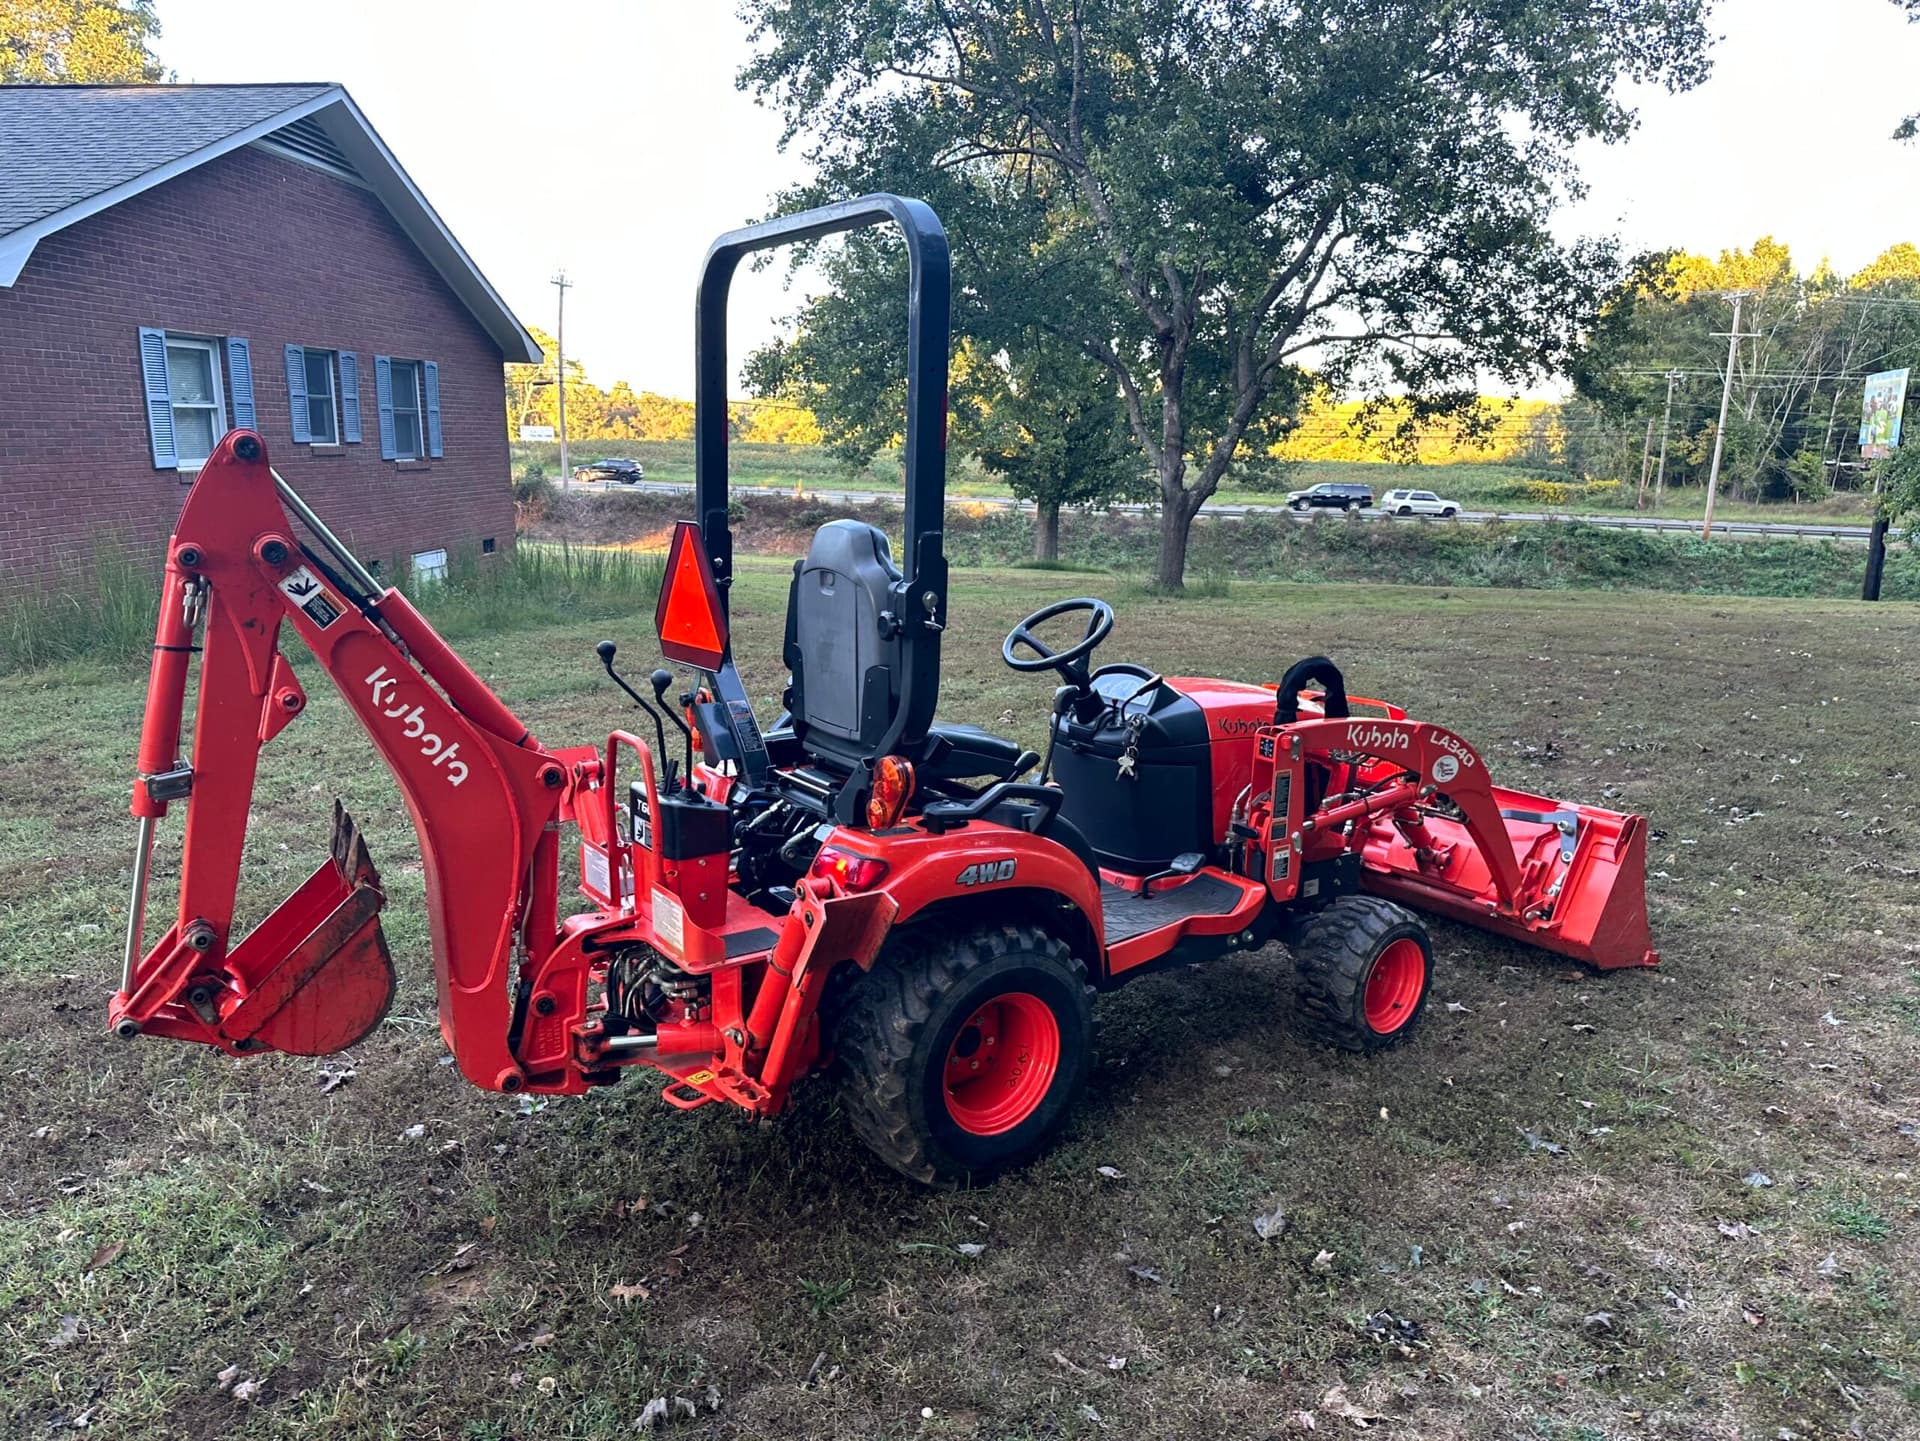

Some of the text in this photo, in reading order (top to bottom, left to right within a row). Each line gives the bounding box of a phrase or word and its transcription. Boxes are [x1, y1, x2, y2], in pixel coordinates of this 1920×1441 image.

[364, 665, 469, 787] Kubota
[1347, 724, 1409, 749] Kubota
[1430, 730, 1475, 767] LA340
[637, 799, 651, 815] T6
[955, 857, 1017, 887] 4WD
